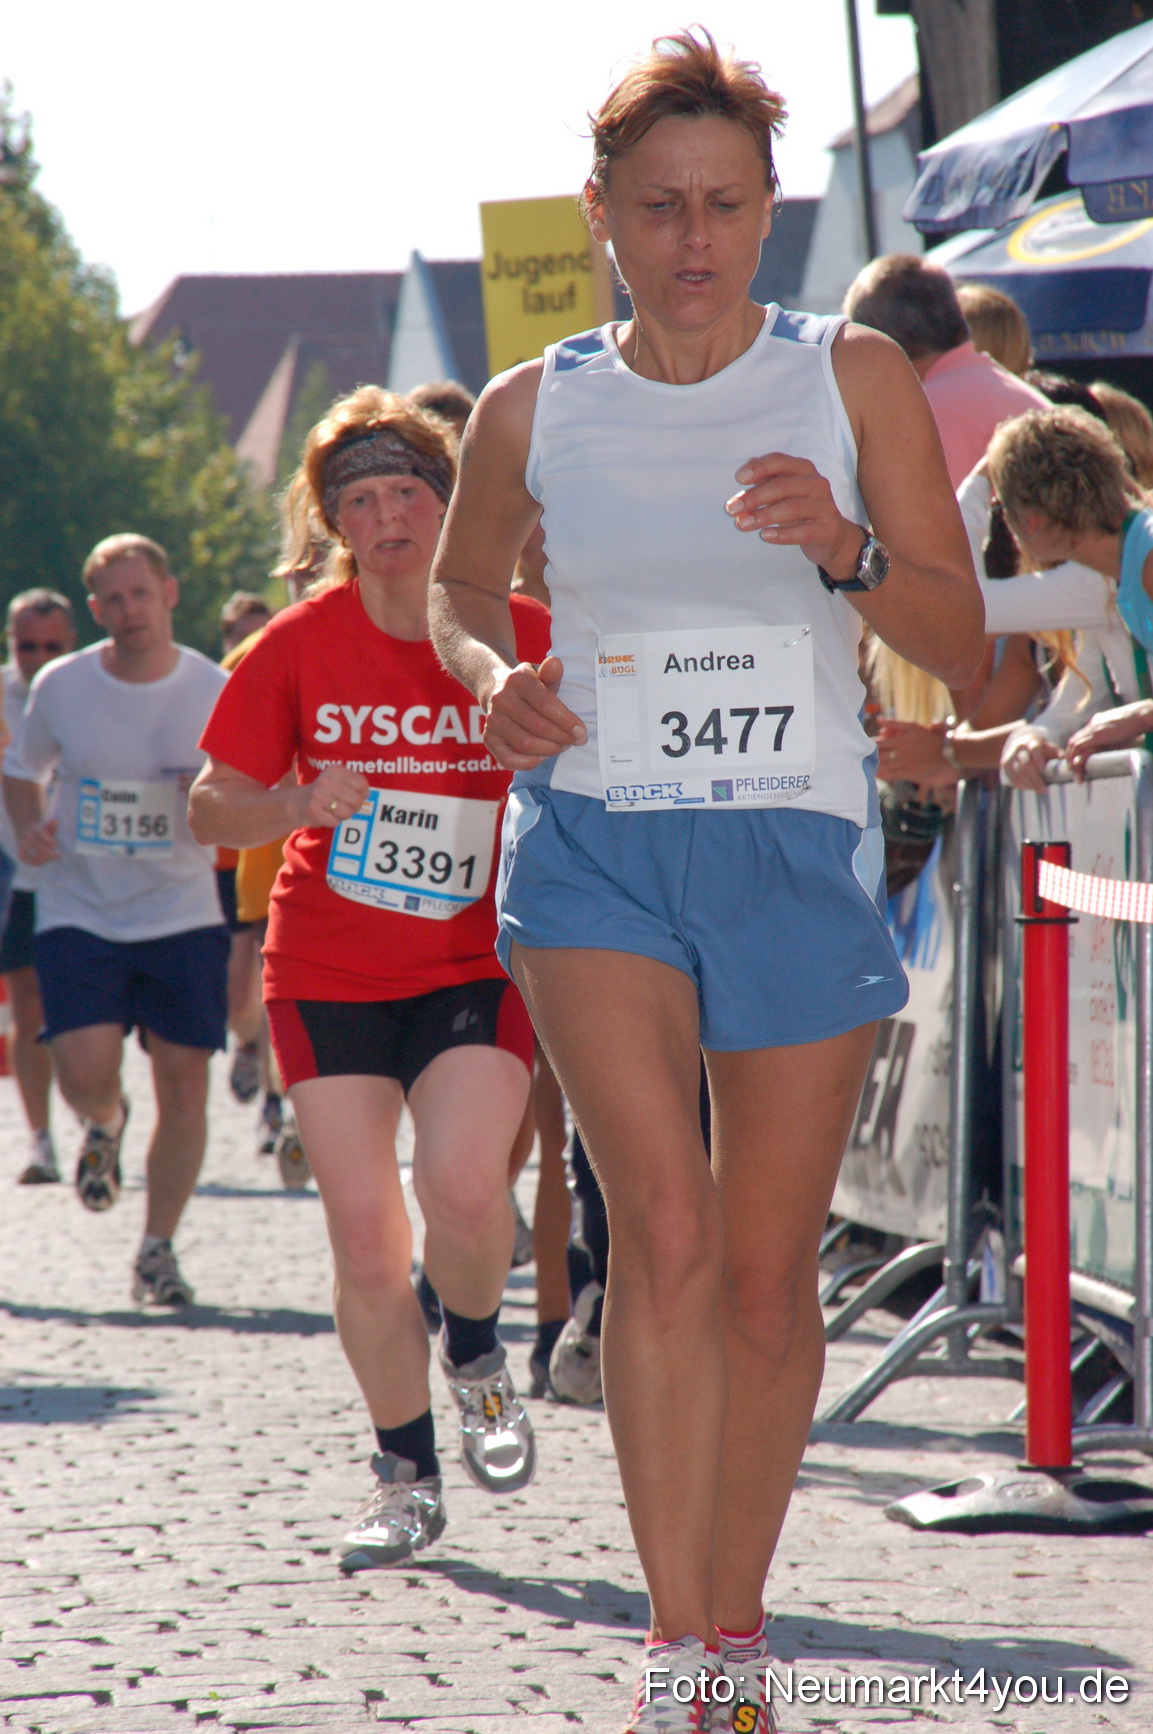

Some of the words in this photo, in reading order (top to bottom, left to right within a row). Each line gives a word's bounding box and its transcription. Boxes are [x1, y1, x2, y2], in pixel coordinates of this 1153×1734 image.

[522, 280, 576, 314] lauf
[663, 650, 755, 674] Andrea
[660, 705, 795, 758] 3477
[606, 782, 683, 802] BOCK
[736, 775, 811, 792] PFLEIDERER
[103, 813, 169, 838] 3156
[380, 804, 439, 831] Karin
[344, 827, 361, 845] D
[374, 840, 476, 889] 3391
[734, 1705, 757, 1733] S
